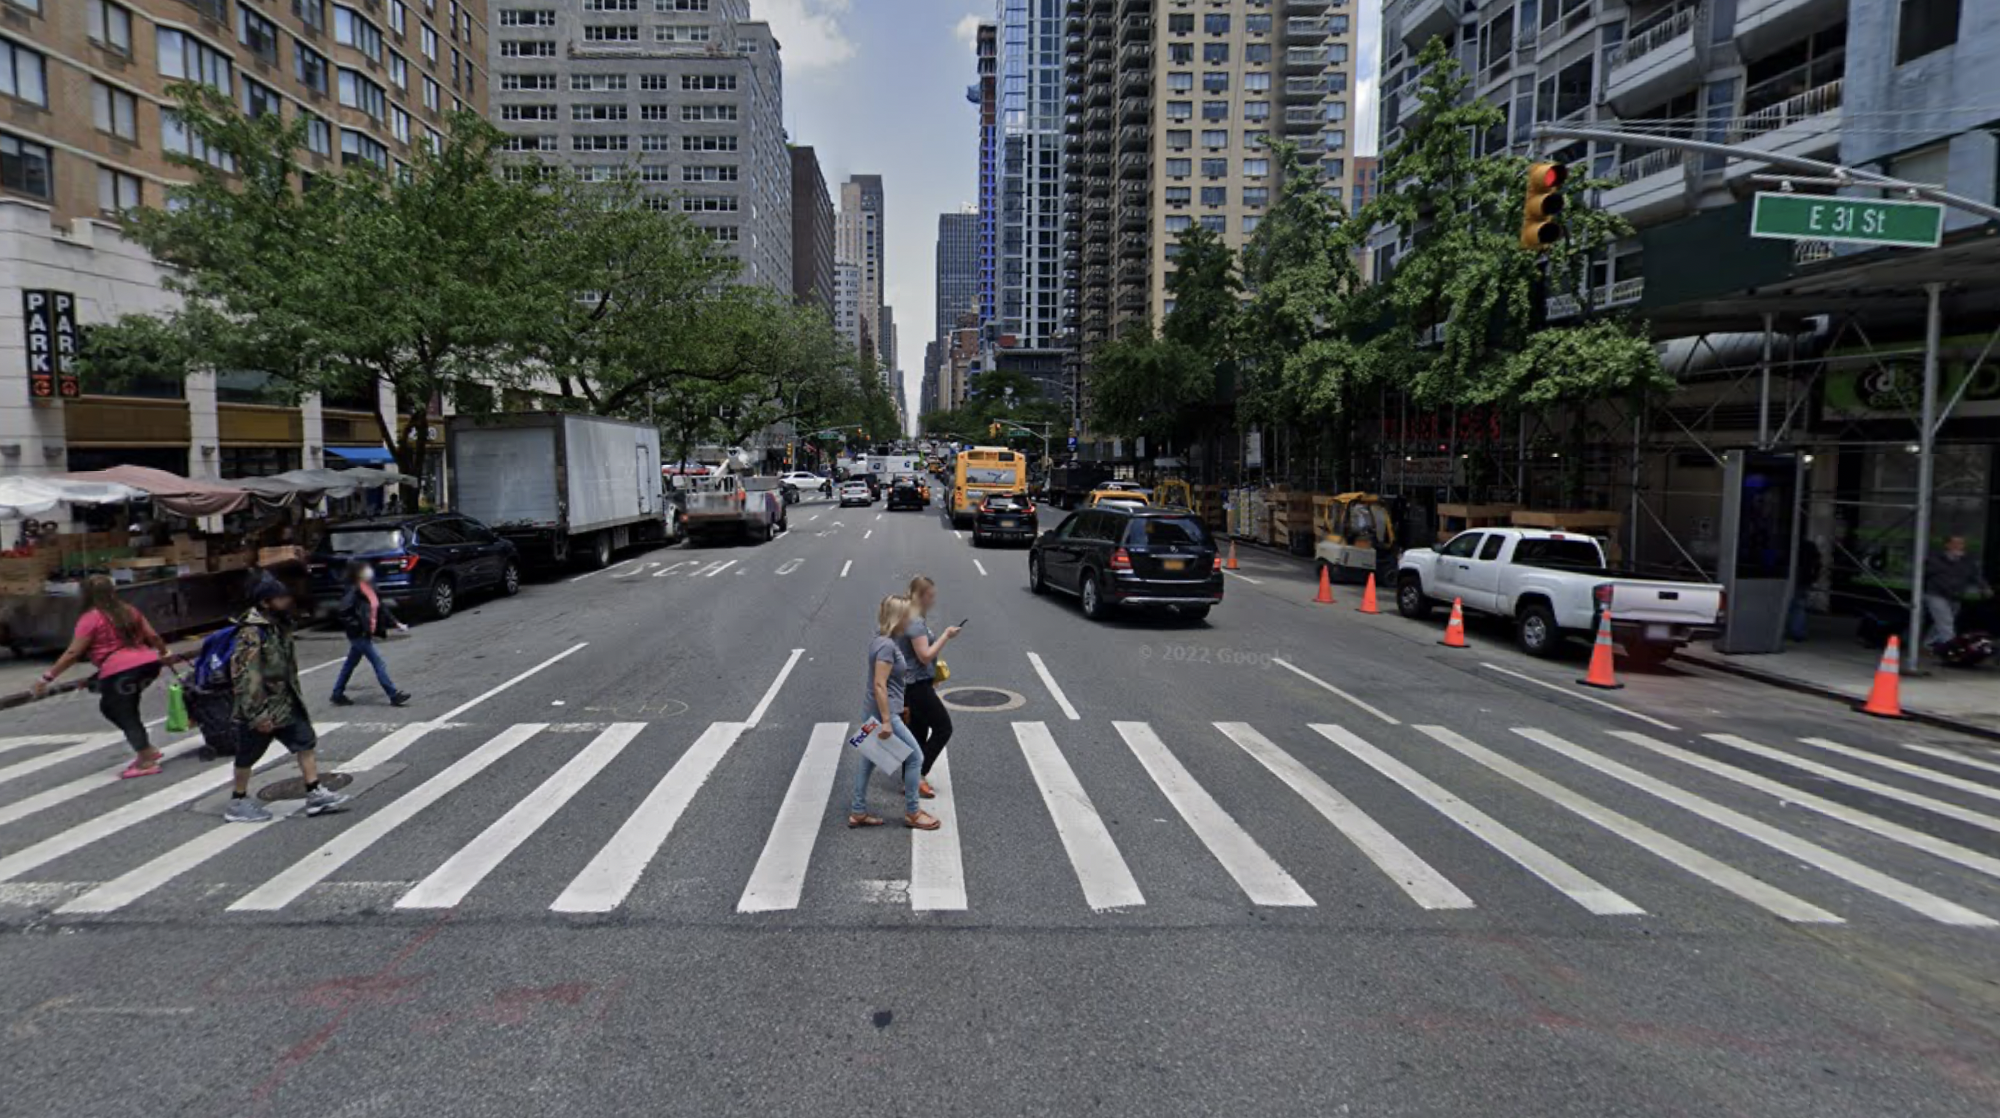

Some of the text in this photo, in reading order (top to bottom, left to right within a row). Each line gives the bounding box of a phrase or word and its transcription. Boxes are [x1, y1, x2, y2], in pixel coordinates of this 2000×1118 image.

[1809, 205, 1886, 233] E 31 St
[27, 293, 49, 372] PARK
[56, 295, 75, 372] PARK
[849, 720, 879, 748] FedEx
